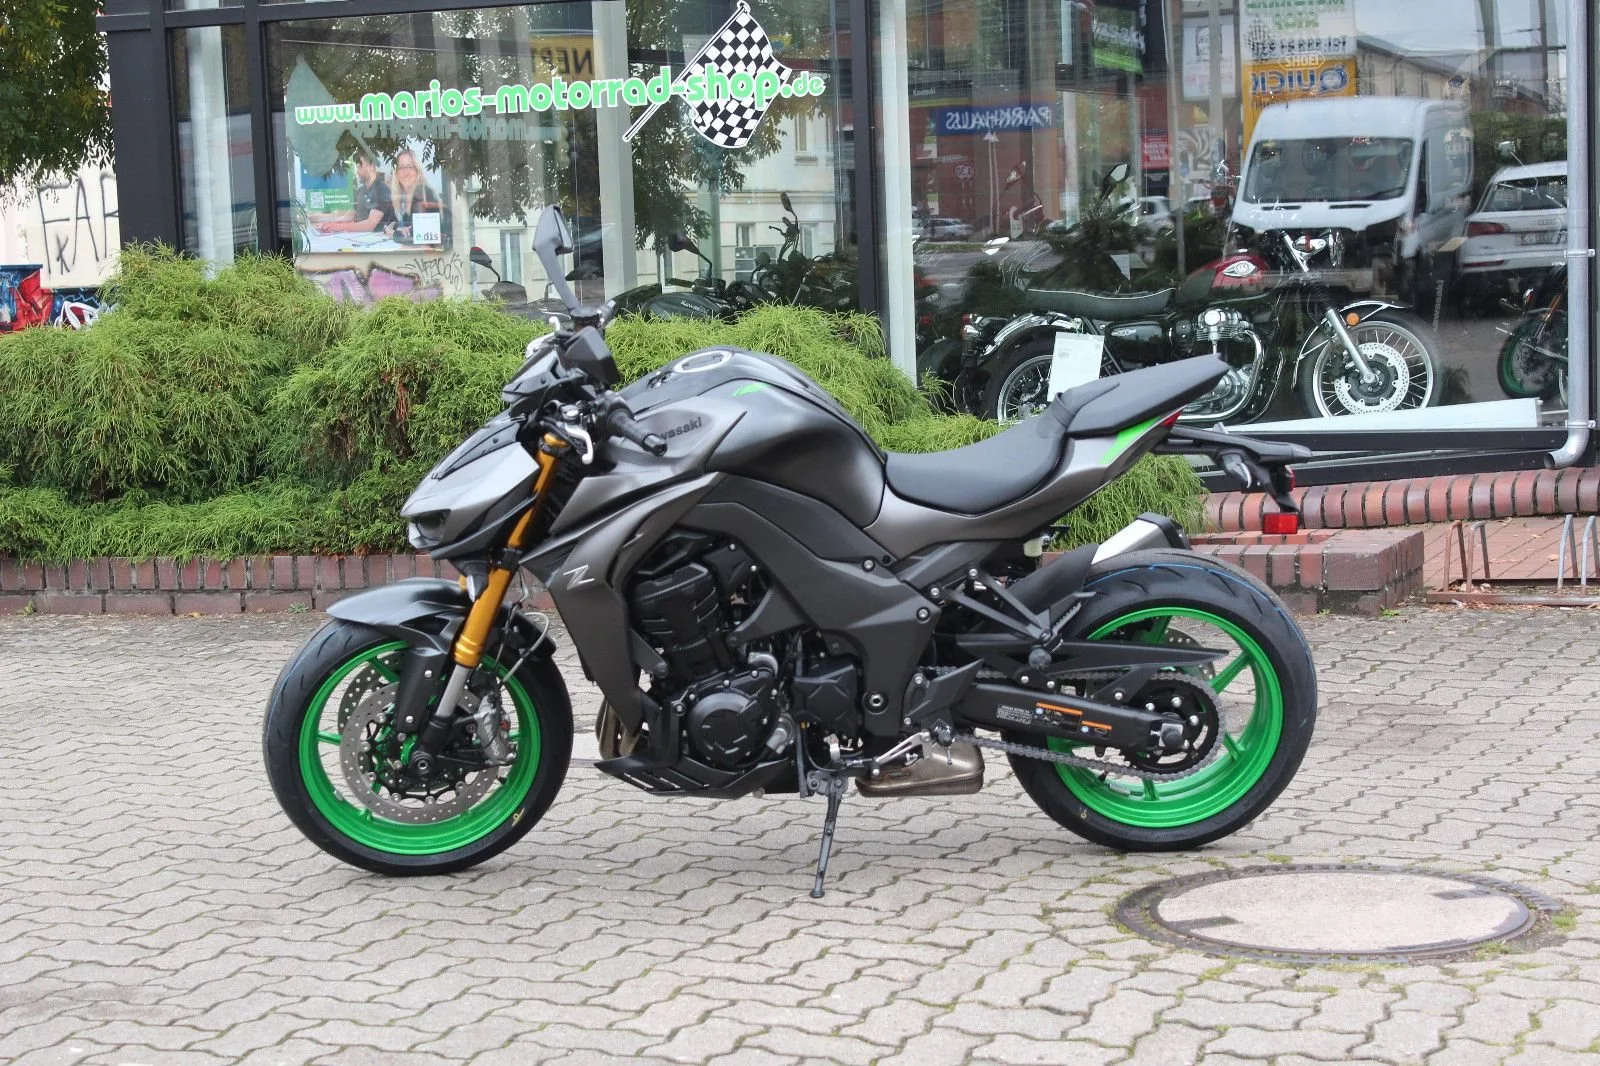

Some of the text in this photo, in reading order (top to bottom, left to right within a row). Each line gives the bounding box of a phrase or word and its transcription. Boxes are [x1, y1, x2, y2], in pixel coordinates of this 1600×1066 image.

[295, 63, 826, 126] www.marios-motorrad-shop.de
[660, 416, 703, 440] wasaki
[563, 564, 595, 590] Z
